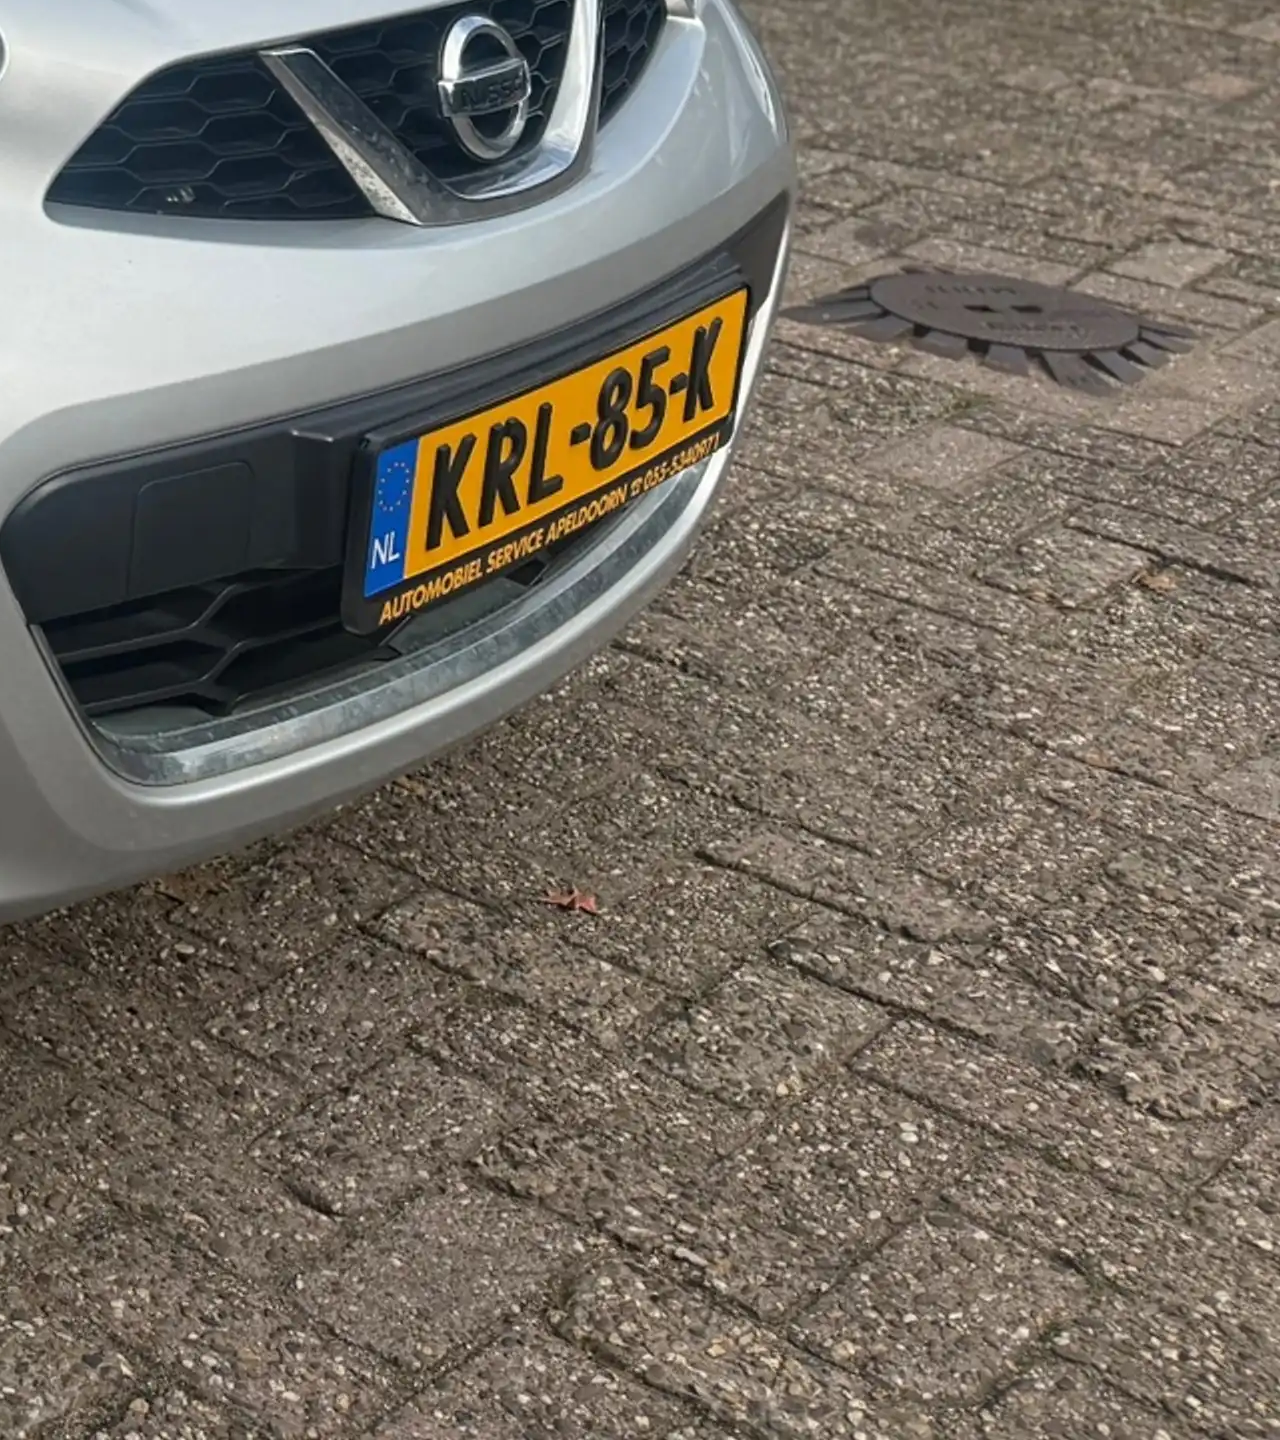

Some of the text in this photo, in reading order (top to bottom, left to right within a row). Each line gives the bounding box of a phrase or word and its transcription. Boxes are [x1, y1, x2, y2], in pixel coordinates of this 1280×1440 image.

[424, 315, 724, 553] KRL-85-K
[371, 531, 401, 570] NL
[378, 558, 483, 625] AUTOMOBIEL
[486, 527, 544, 573] SERVICE
[544, 483, 628, 546] APELDOORN
